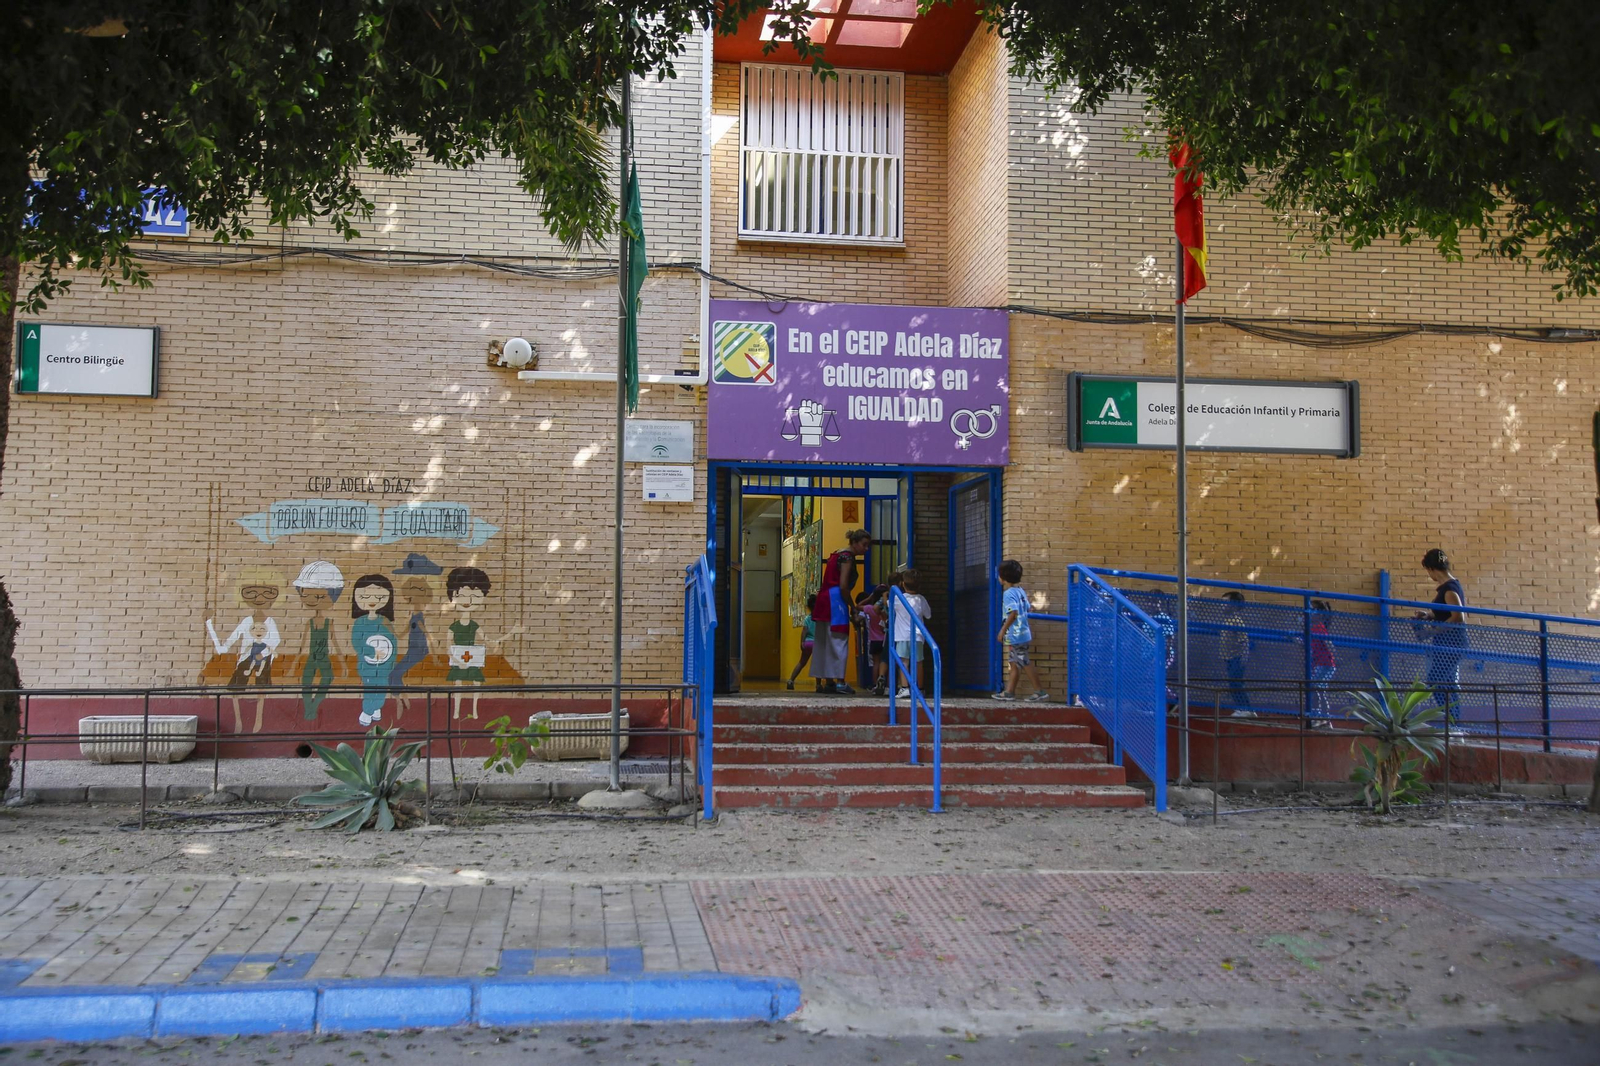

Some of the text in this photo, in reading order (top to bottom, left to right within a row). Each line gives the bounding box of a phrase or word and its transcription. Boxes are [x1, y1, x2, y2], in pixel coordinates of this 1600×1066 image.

[788, 328, 1003, 360] En el CEIP Adela Díaz
[46, 354, 125, 367] Centro Bilingüe
[823, 363, 968, 391] educamos en
[848, 395, 943, 423] IGUALDAD
[1148, 403, 1340, 417] Coleg de Educación Infantil y Primaria
[340, 478, 375, 493] ADELA
[383, 477, 414, 493] DÍAZ
[277, 508, 298, 529] POR
[302, 508, 316, 529] UN
[319, 507, 367, 530] FUTURO
